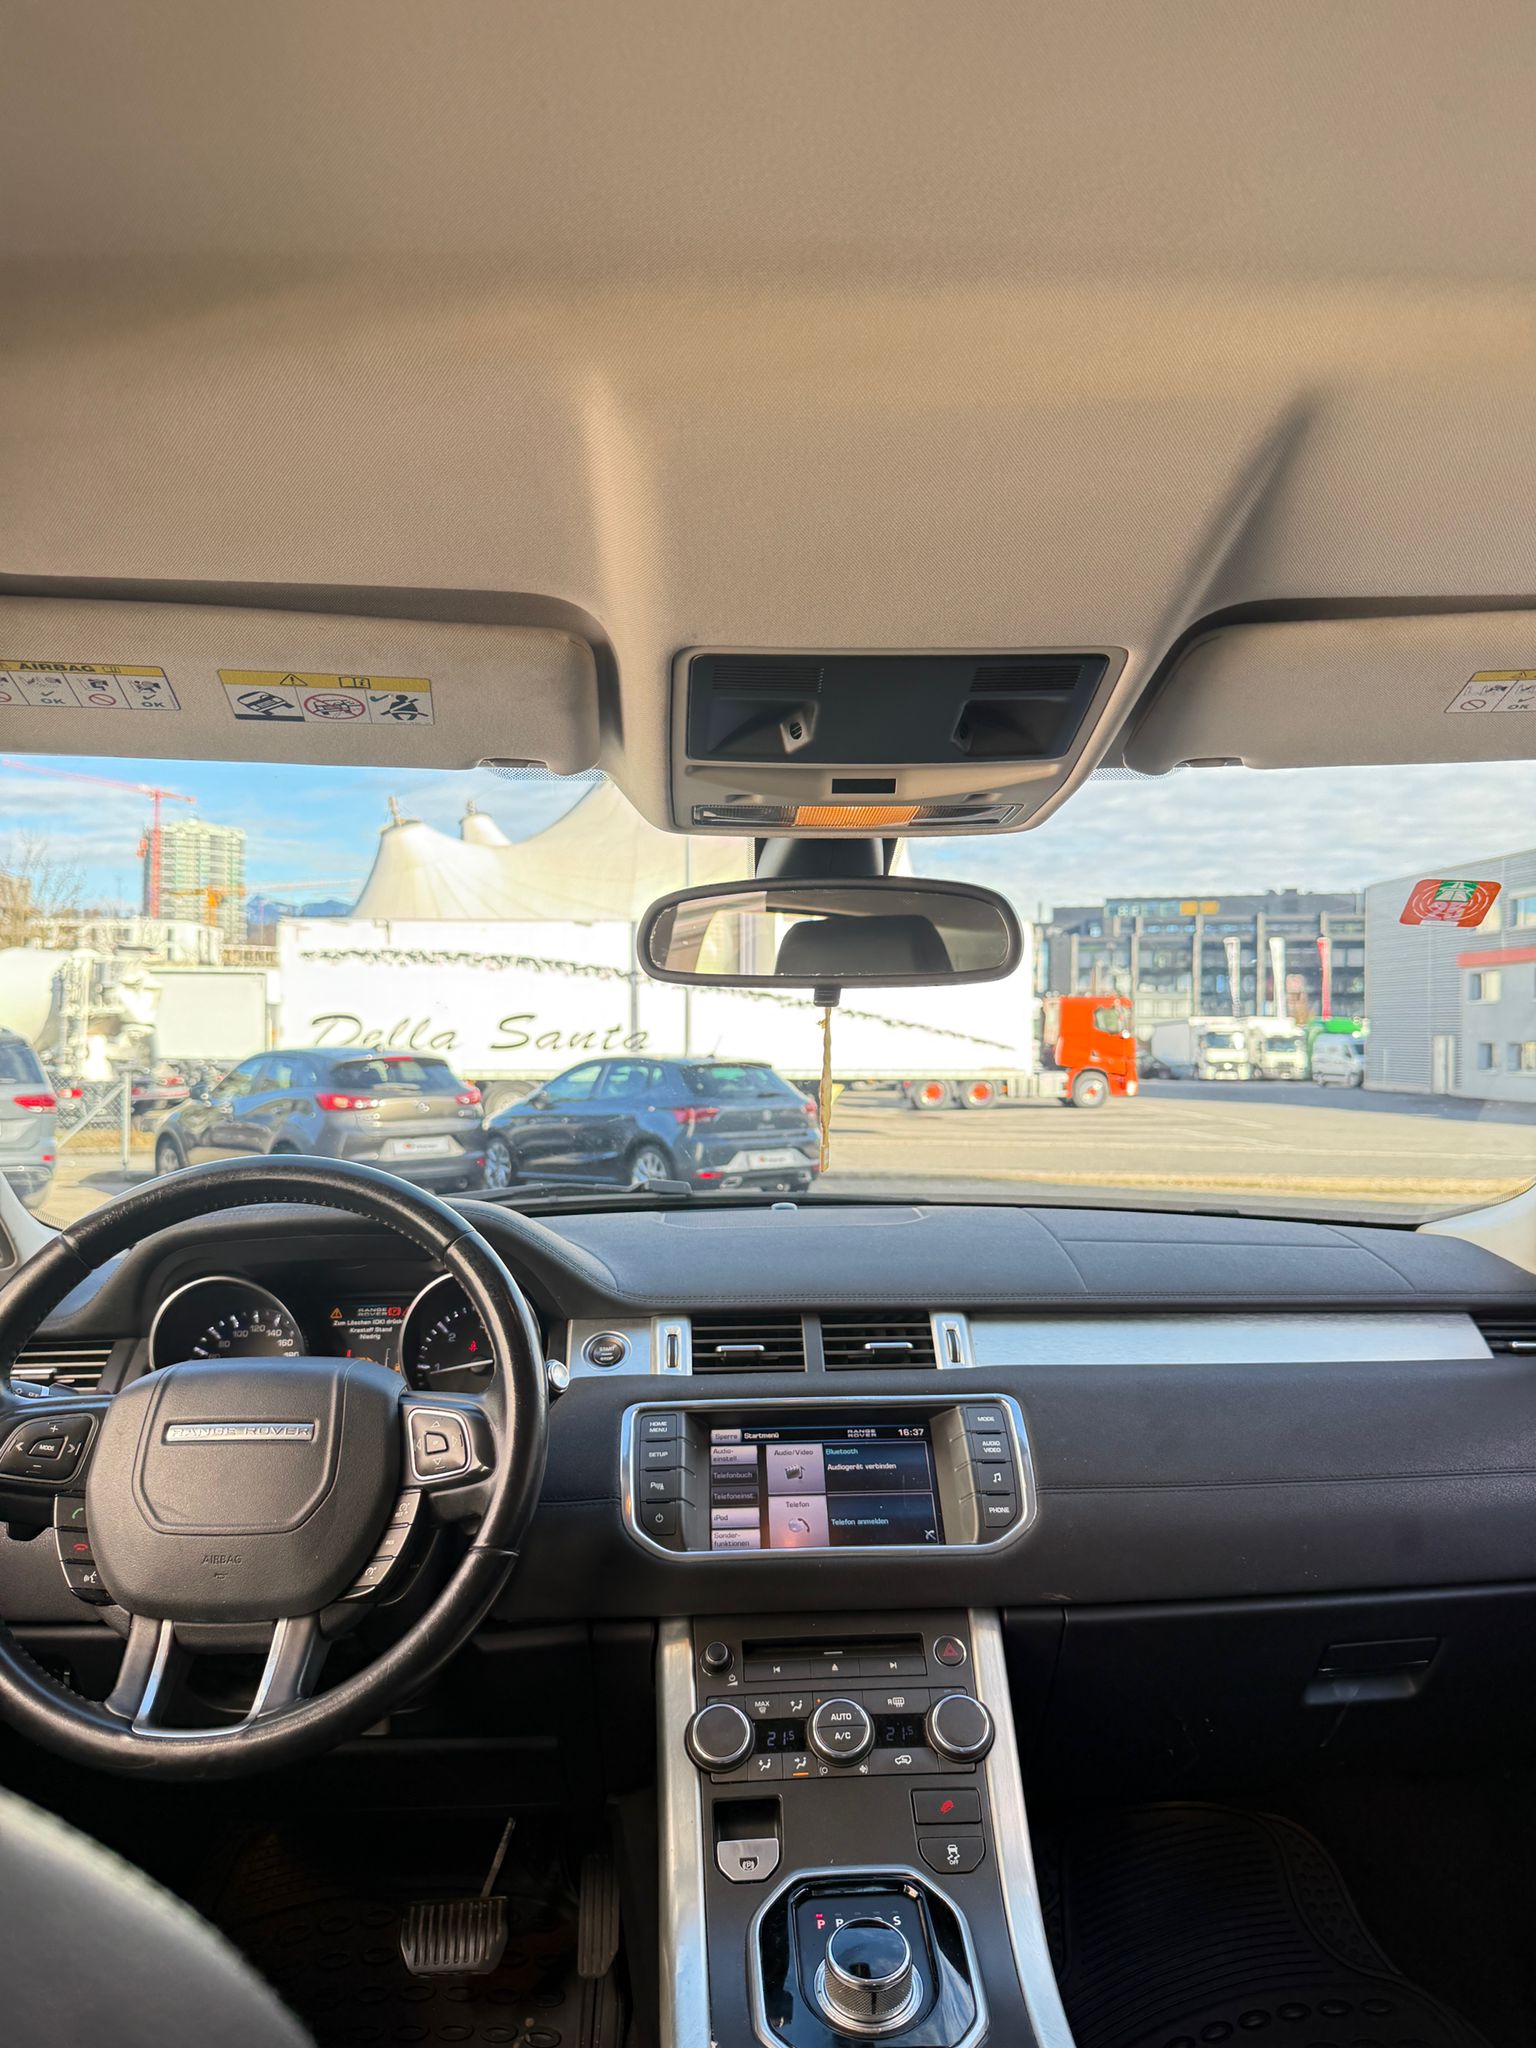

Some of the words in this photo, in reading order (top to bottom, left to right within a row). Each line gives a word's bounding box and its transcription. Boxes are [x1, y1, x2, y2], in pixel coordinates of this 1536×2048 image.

[19, 662, 95, 673] AIRBAG
[41, 697, 65, 705] OK
[311, 1013, 462, 1051] Della
[488, 1013, 654, 1052] Santa
[250, 1324, 266, 1332] 120
[233, 1330, 249, 1338] 100
[266, 1329, 282, 1337] 140
[448, 1332, 457, 1343] 2
[276, 1339, 293, 1347] 160
[243, 1426, 310, 1436] ROVER
[744, 1431, 779, 1439] Startmenü
[38, 1444, 55, 1452] MODE
[827, 1463, 864, 1472] Audiogerät
[865, 1462, 897, 1470] verbinden
[831, 1518, 856, 1526] Telefon
[201, 1554, 242, 1564] AIRBAG
[830, 1712, 852, 1721] AUTO
[834, 1732, 851, 1741] A/C
[817, 1919, 826, 1929] P
[892, 1915, 902, 1926] S
